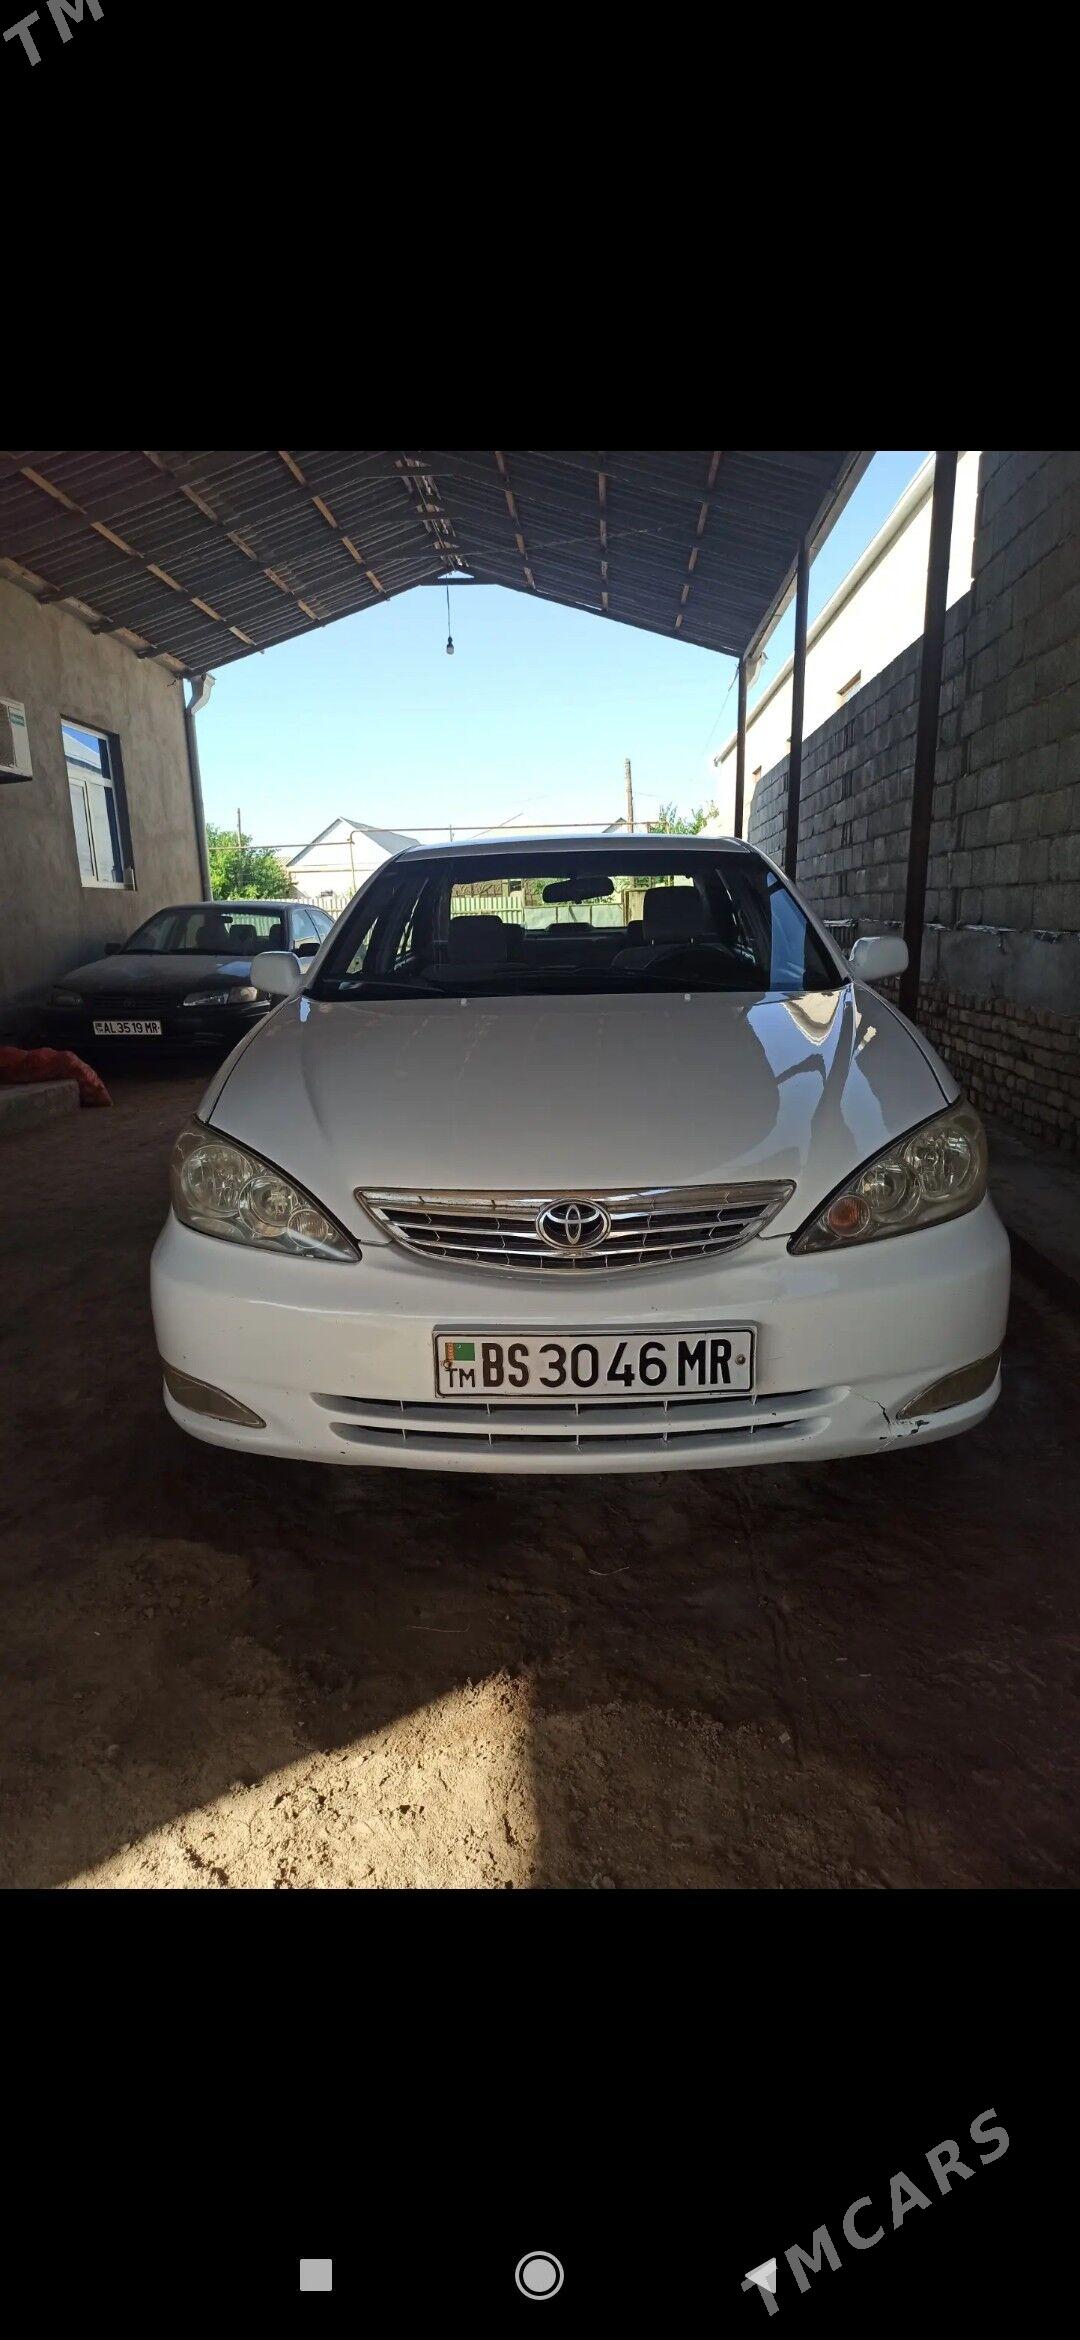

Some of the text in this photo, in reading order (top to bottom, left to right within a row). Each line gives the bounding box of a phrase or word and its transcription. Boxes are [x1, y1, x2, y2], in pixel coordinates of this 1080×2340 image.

[104, 1022, 158, 1034] AL 3519 MR
[449, 1368, 475, 1387] TM
